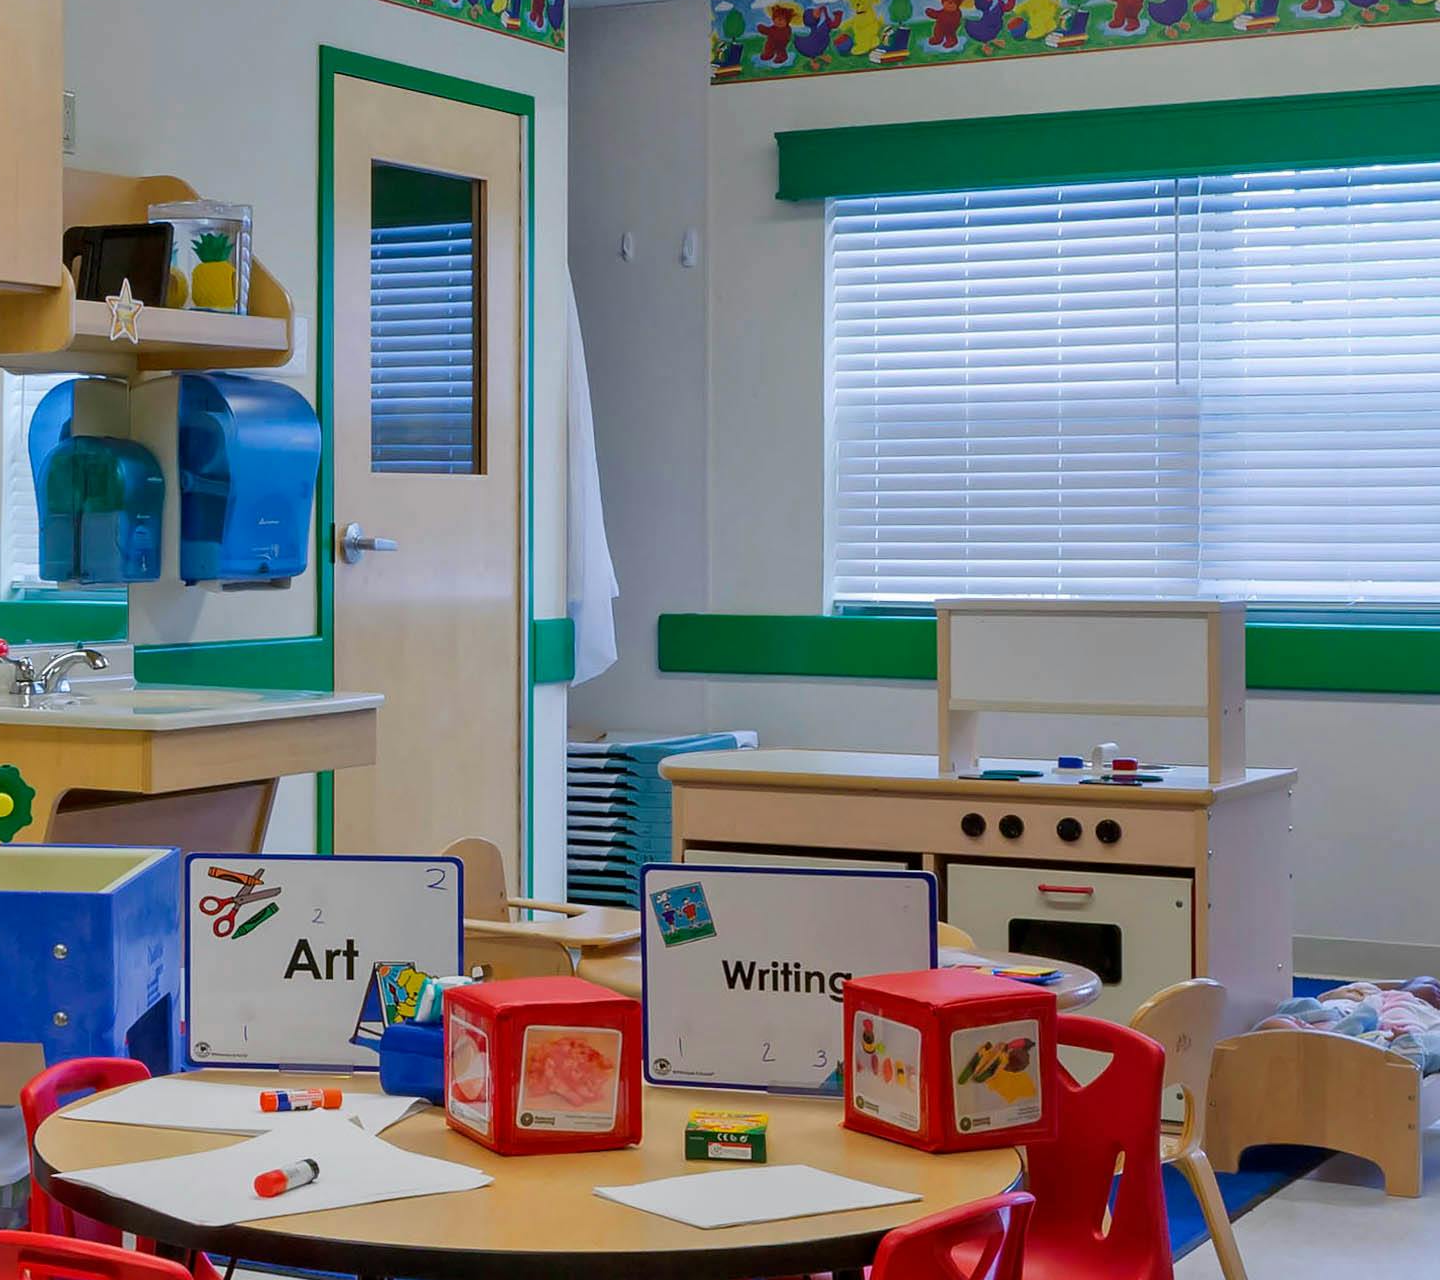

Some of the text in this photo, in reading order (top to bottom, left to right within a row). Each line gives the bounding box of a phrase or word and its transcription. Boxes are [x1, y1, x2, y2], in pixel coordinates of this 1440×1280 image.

[426, 868, 449, 891] 2
[283, 938, 360, 981] Art
[722, 959, 852, 1003] Writing
[762, 1042, 776, 1063] 2
[812, 1049, 828, 1069] 3
